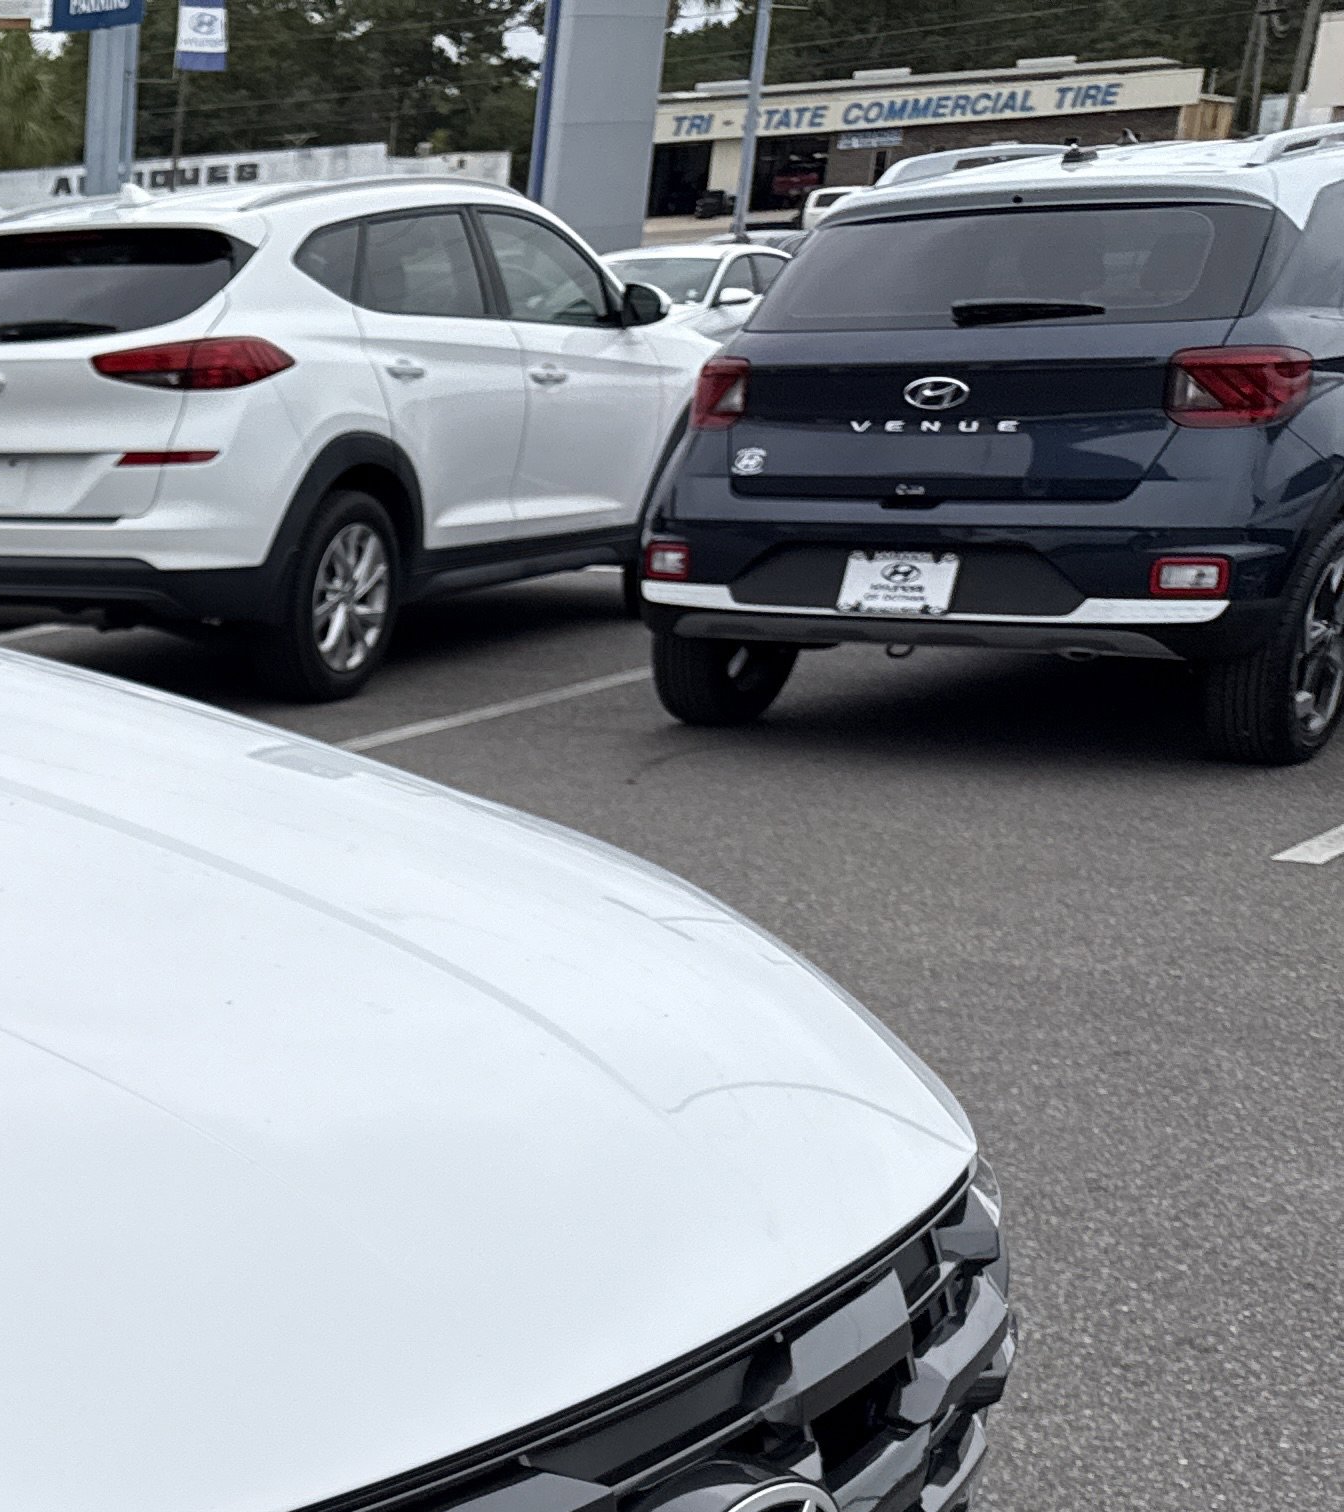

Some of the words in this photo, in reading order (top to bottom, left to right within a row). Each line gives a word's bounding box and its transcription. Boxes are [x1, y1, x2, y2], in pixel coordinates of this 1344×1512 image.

[672, 113, 715, 137] TRI
[842, 88, 1036, 126] COMMERCIAL
[1055, 82, 1123, 110] TIRE
[51, 163, 259, 197] AIQUES
[849, 419, 1021, 434] VENUE
